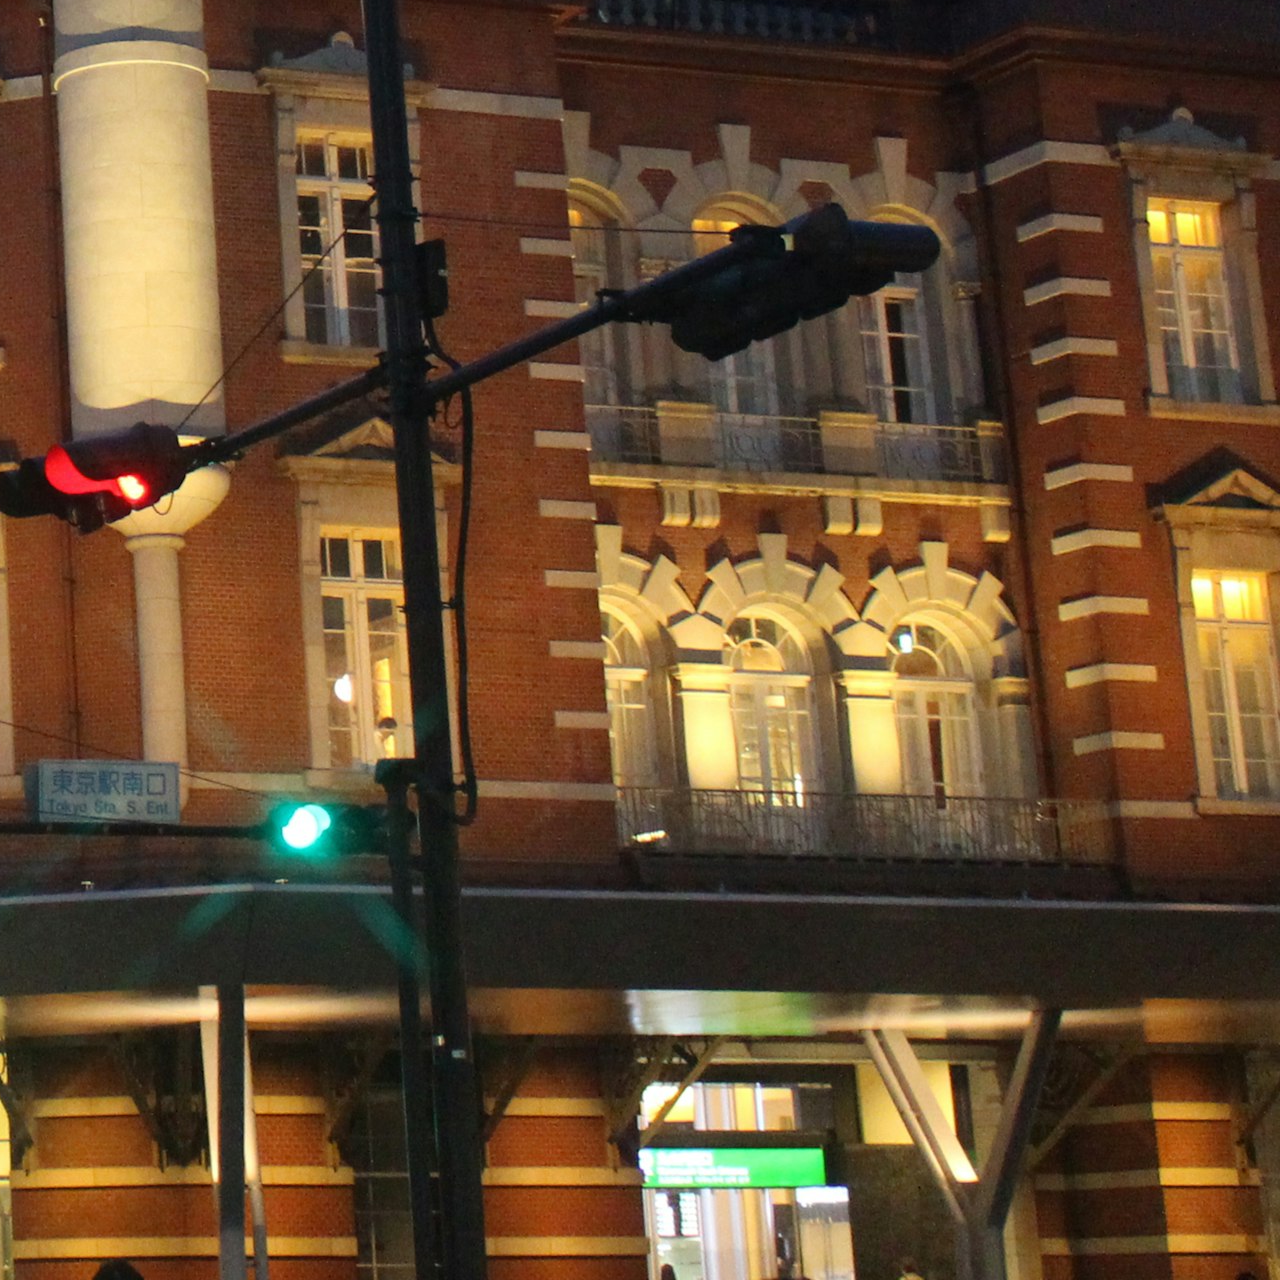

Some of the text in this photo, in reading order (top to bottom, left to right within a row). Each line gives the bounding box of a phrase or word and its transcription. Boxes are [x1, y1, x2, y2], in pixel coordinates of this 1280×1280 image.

[51, 769, 166, 796] 東京駅南口
[47, 799, 87, 816] Tokyo
